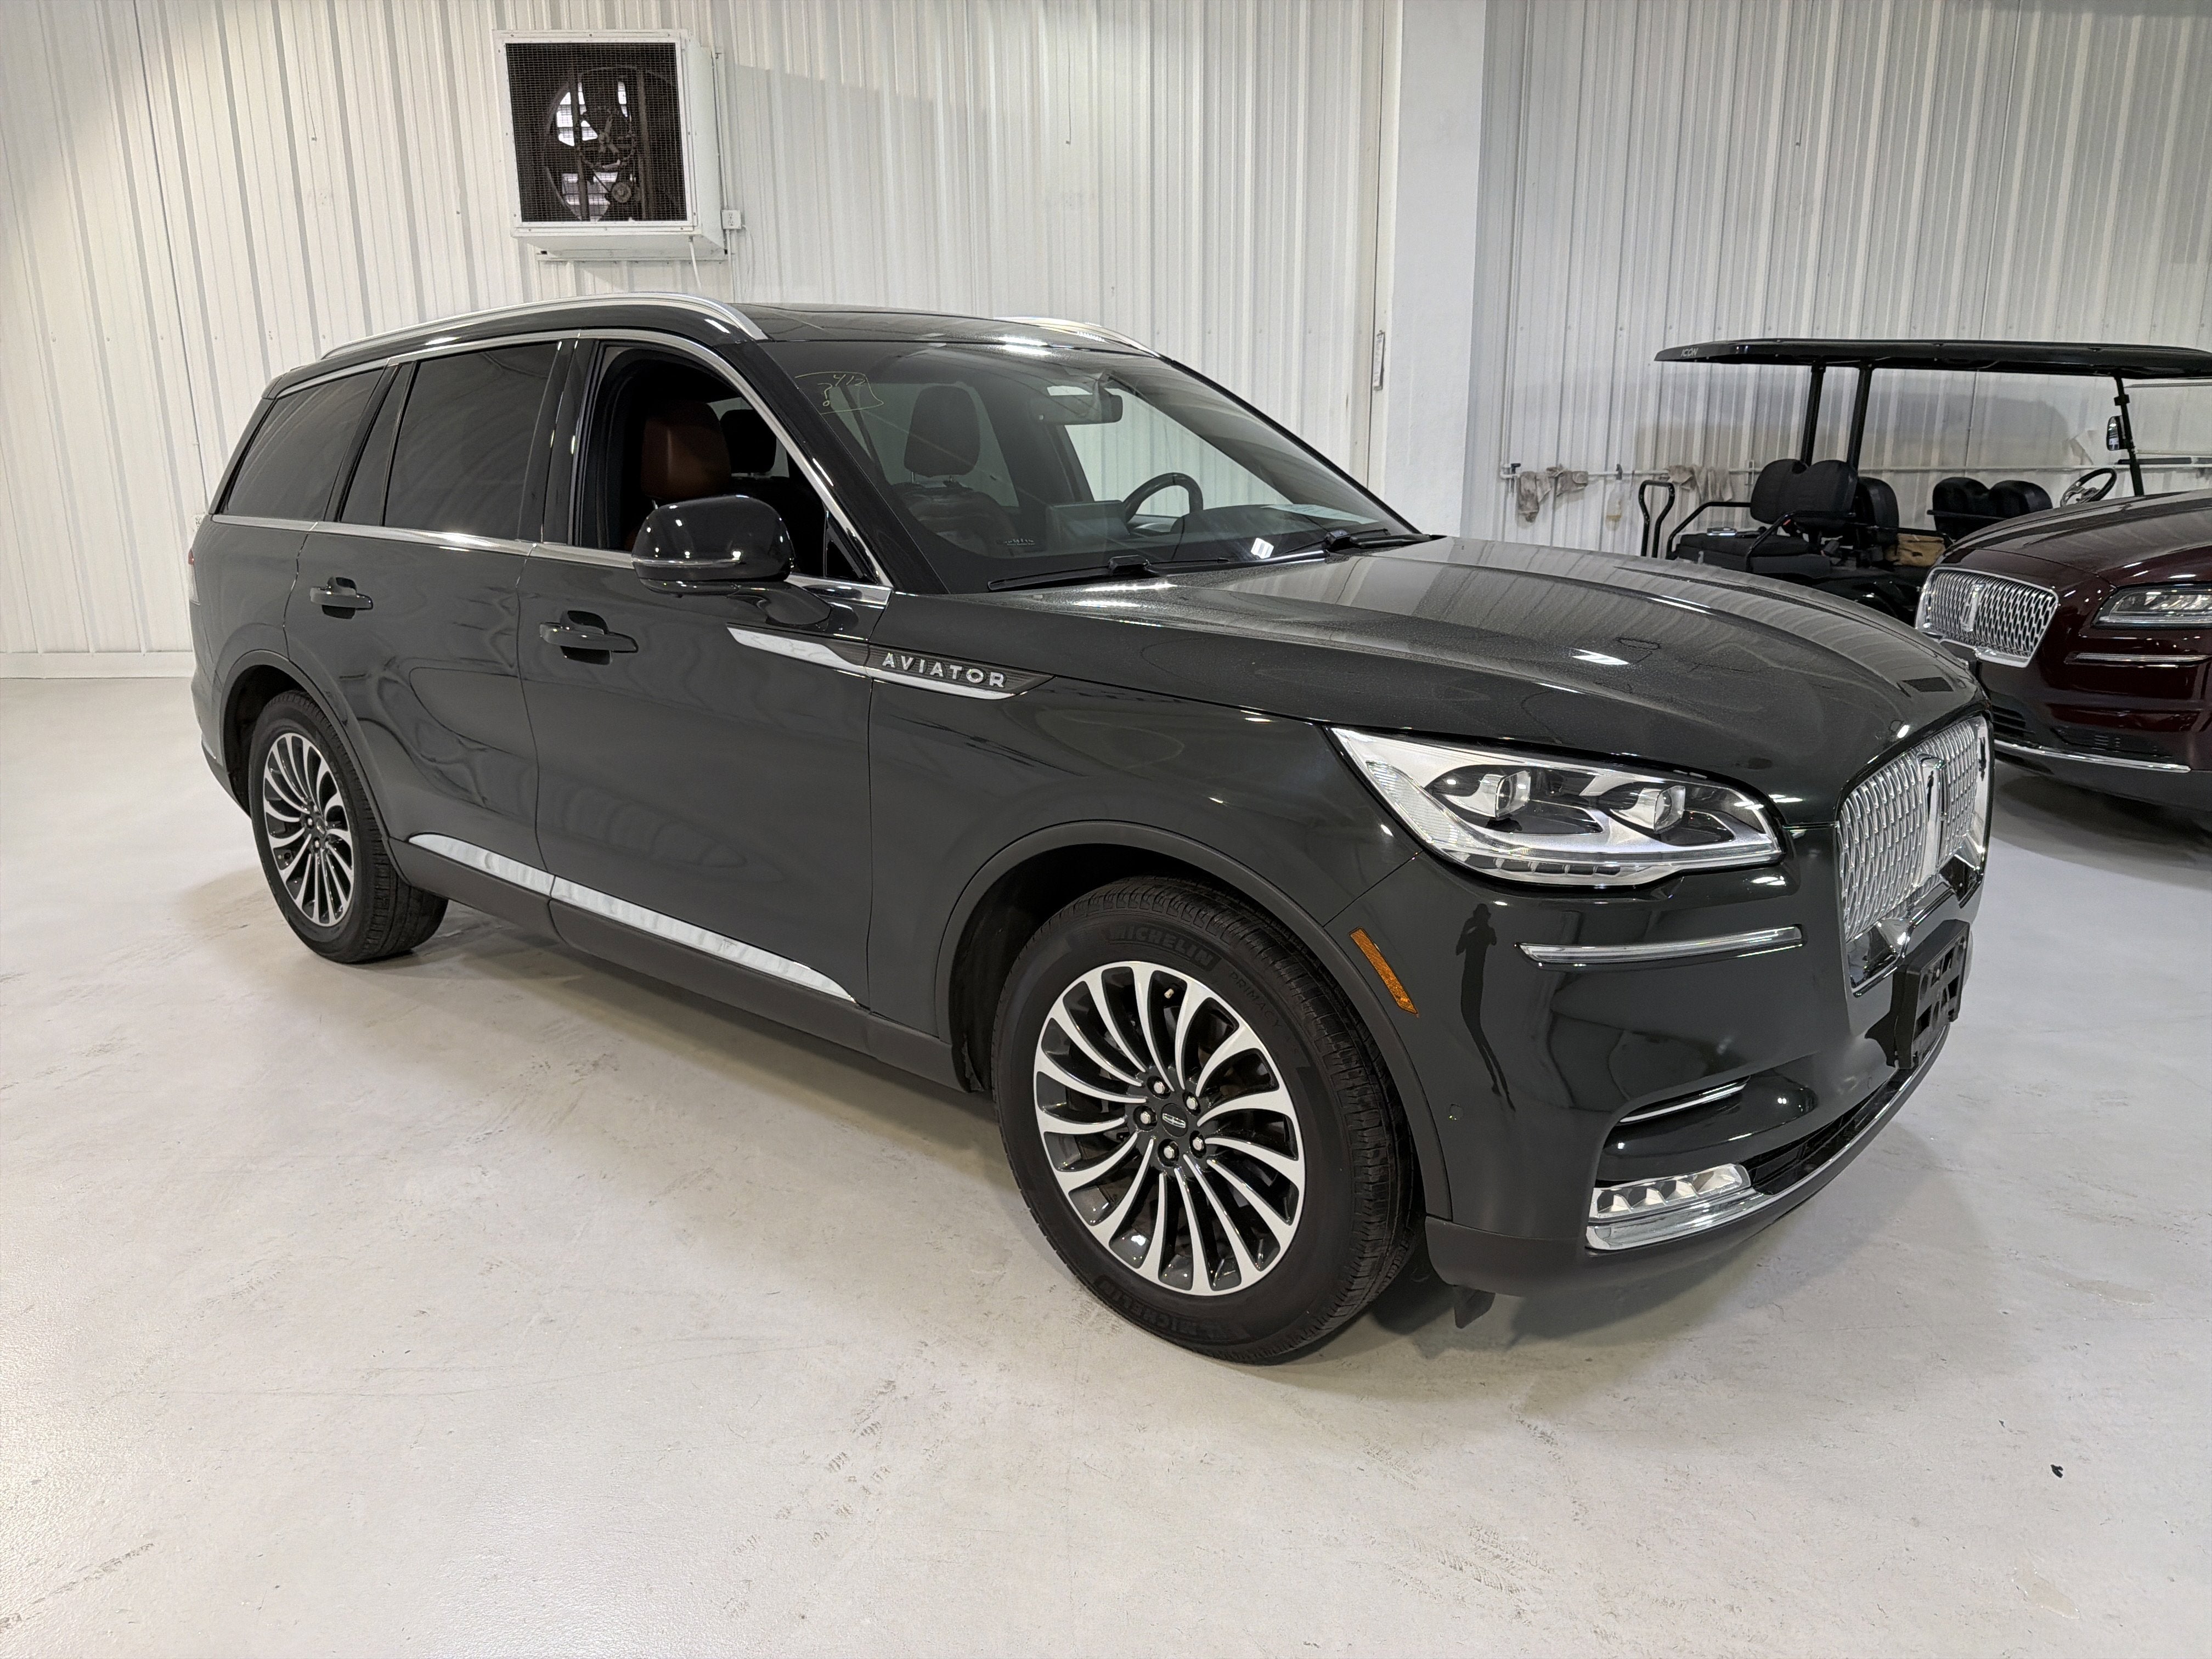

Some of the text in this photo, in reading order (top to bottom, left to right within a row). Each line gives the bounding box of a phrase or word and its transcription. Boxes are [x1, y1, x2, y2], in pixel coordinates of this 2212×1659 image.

[1680, 347, 1699, 357] ICON
[882, 652, 1006, 688] AVIATOR
[1109, 924, 1214, 967] MICHELIN
[1228, 971, 1283, 1028] PRIMACY
